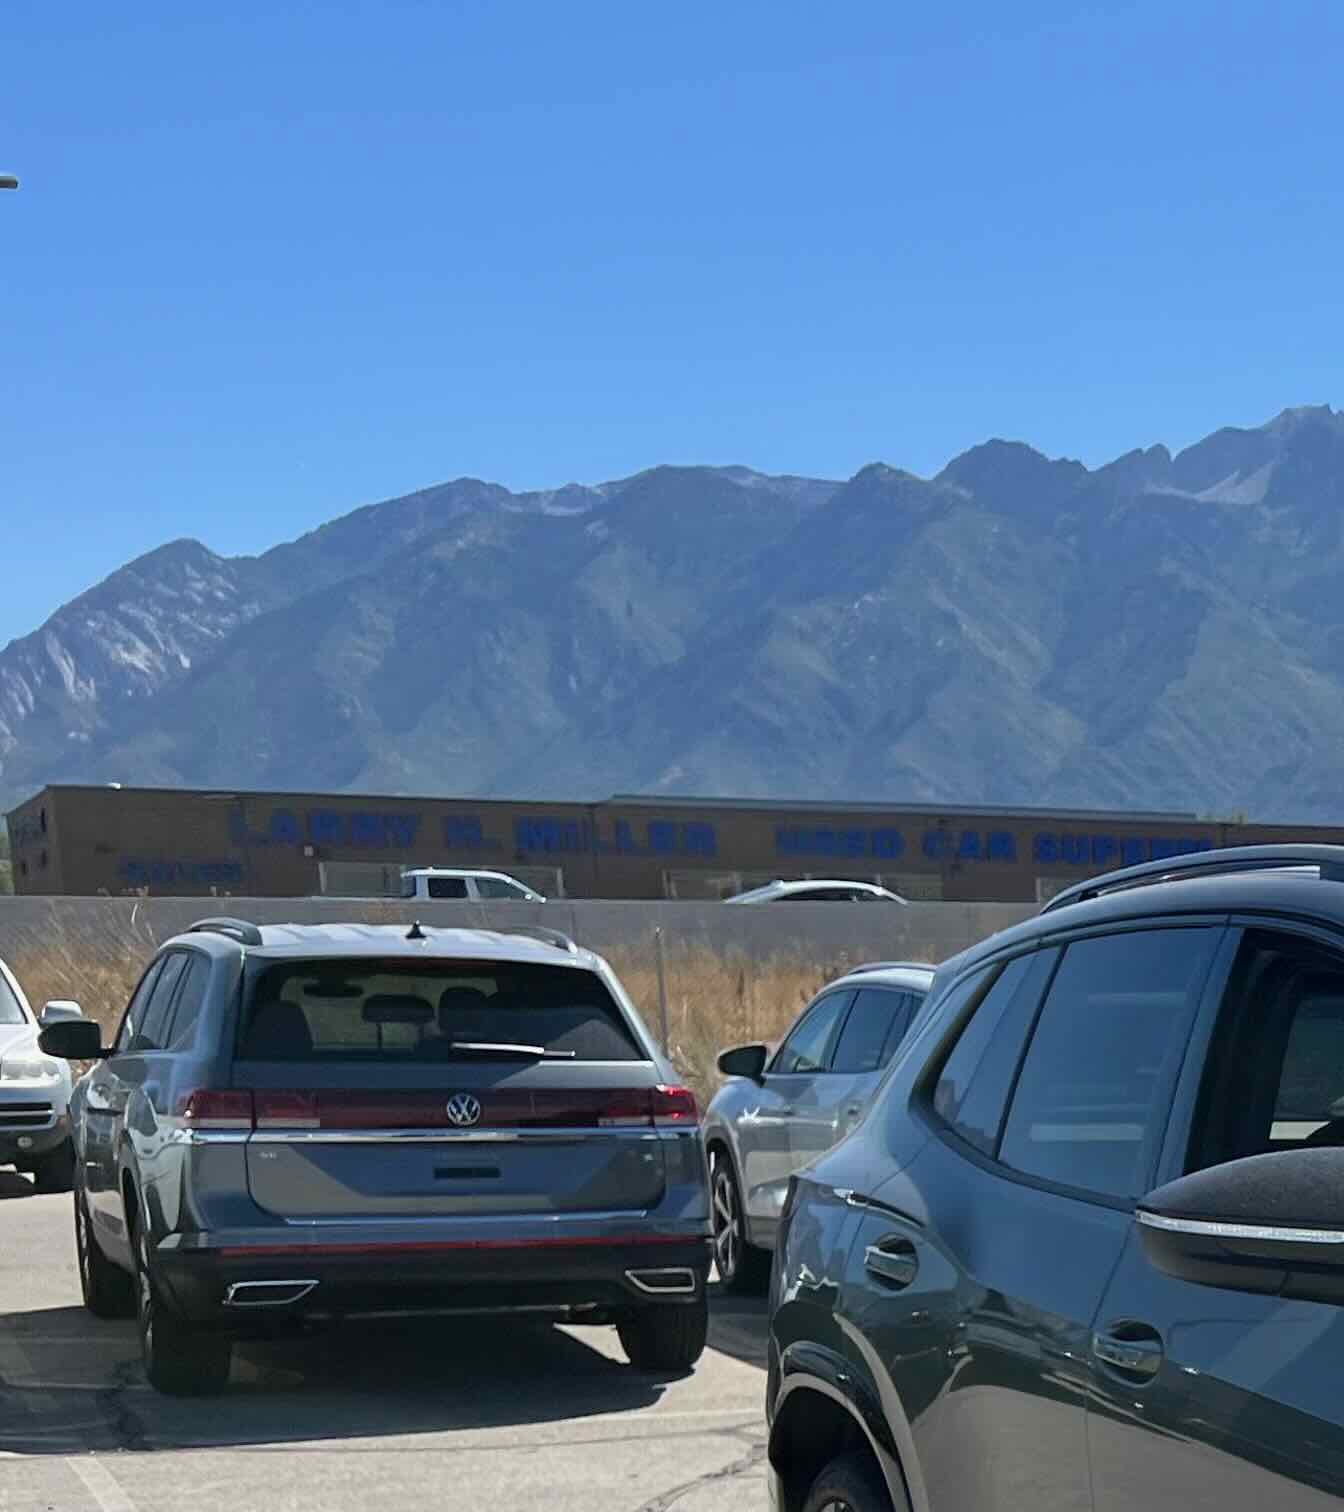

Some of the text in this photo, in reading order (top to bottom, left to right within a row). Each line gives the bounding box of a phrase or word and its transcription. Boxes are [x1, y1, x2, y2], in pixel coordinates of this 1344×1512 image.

[228, 806, 418, 850] LARRY
[516, 815, 717, 858] MILLER
[923, 831, 1018, 865] CAR
